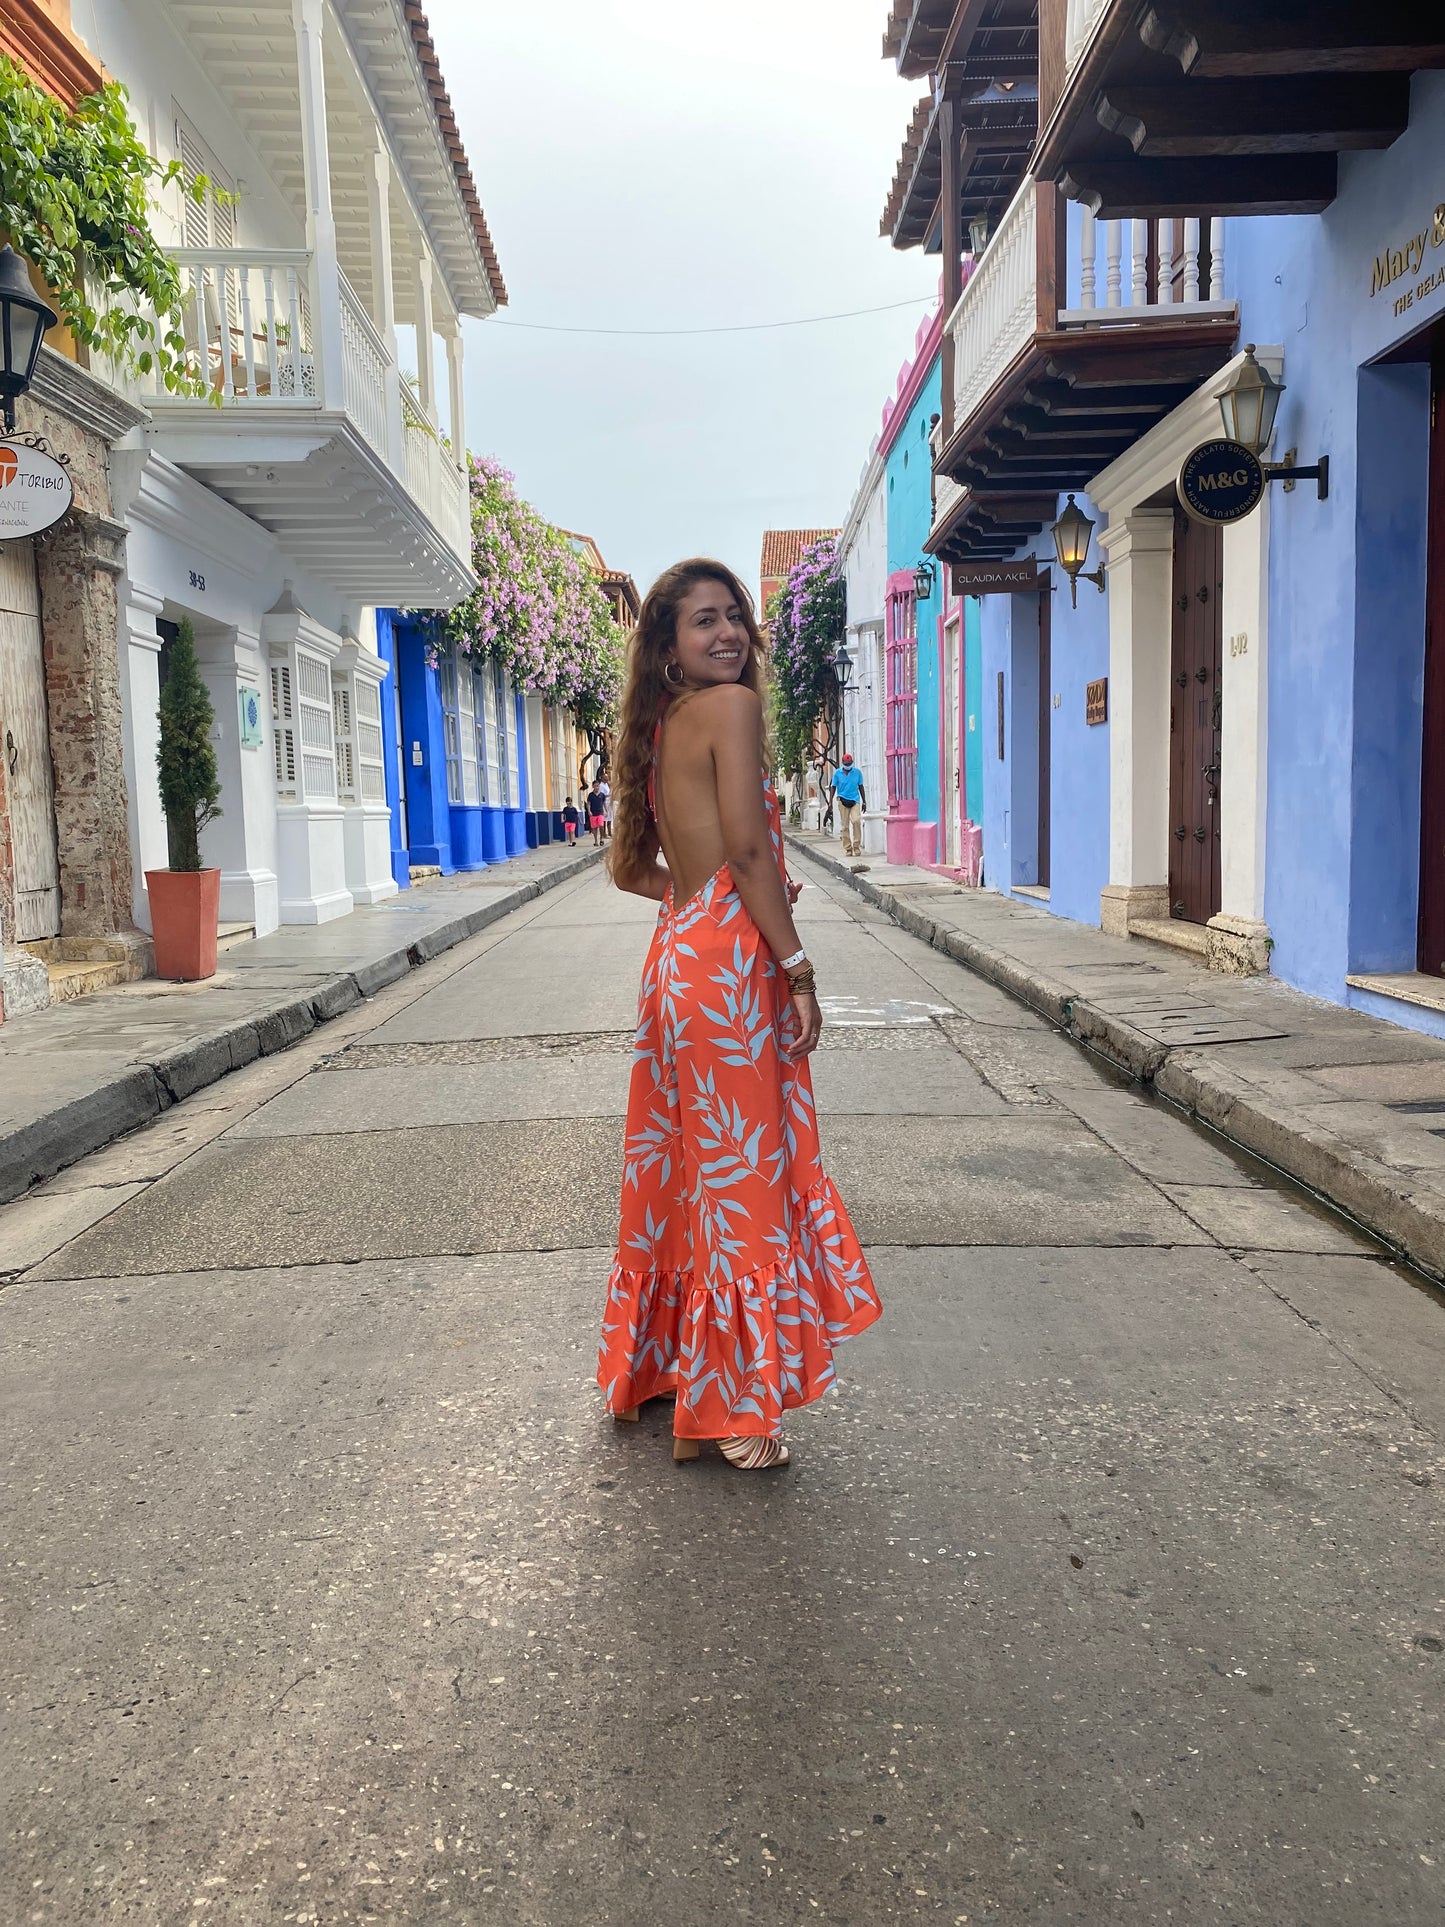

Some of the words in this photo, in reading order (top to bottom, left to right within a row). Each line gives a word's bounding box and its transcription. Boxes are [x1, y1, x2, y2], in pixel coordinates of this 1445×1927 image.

[1369, 228, 1428, 298] Mary
[1393, 289, 1413, 317] THE
[1416, 265, 1445, 301] GELA
[1185, 462, 1196, 479] THE
[1194, 444, 1225, 462] GELATO
[1228, 445, 1257, 469] SOCIETY
[19, 473, 64, 490] TORIBIO
[1198, 469, 1248, 491] M&G
[0, 500, 29, 512] ANTE
[1187, 490, 1210, 514] MATCH
[1213, 489, 1259, 517] WONDERFUL
[189, 570, 205, 591] 38-53
[958, 574, 1002, 584] CLAUDIA
[1005, 572, 1032, 582] AKEL
